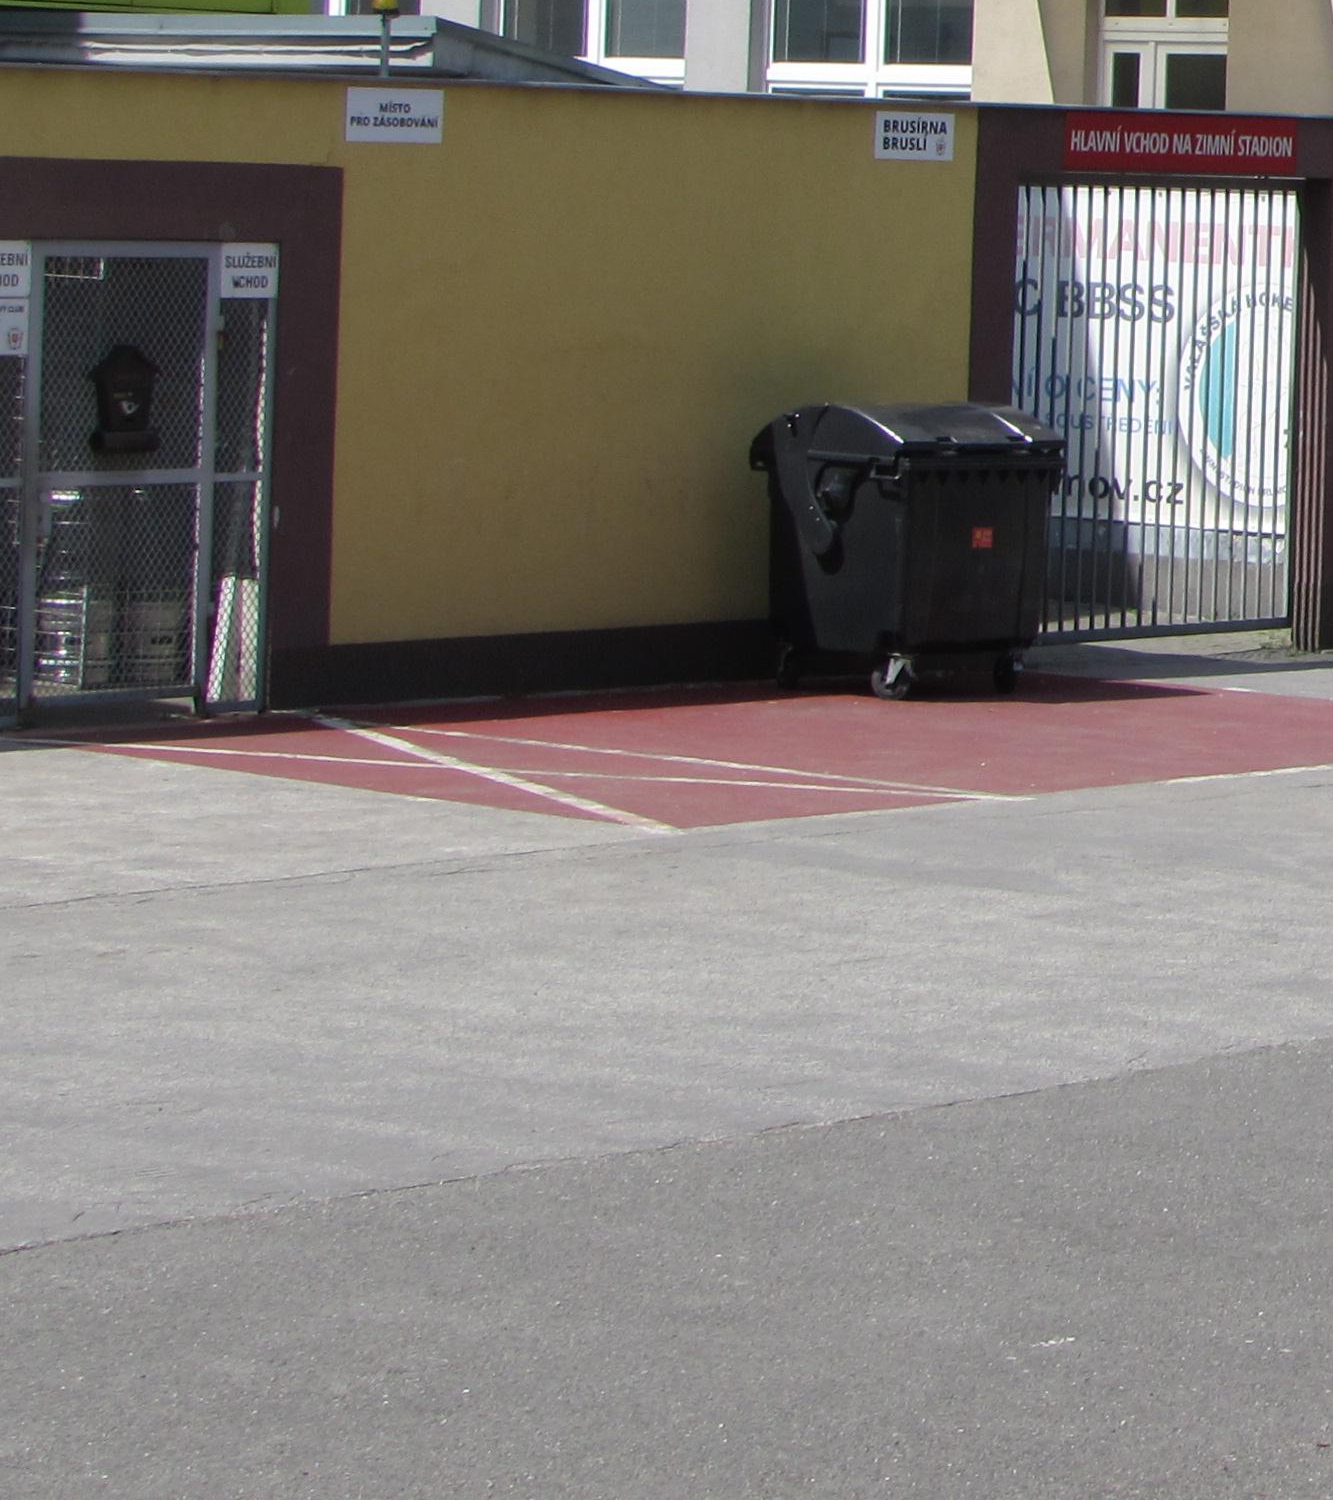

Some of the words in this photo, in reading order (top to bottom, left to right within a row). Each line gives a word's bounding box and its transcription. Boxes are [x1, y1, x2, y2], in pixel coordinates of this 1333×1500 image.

[379, 100, 411, 114] MÍSTO
[350, 116, 370, 127] PRO
[373, 114, 439, 128] ZÁSOBOVÁNÍ
[883, 116, 947, 134] BRUSÍRNA
[882, 132, 927, 151] BRUSLÍ
[1070, 125, 1123, 152] HLAVNÍ
[1124, 131, 1169, 154] VCHOD
[1173, 133, 1192, 155] NA
[1195, 129, 1237, 157] ZIMNÍ
[1237, 135, 1293, 158] STADION
[1016, 215, 1294, 268] ERMANENT
[0, 248, 28, 267] EBNÍ
[225, 251, 277, 268] SLUŽEBNÍ
[1057, 279, 1175, 323] BBSS
